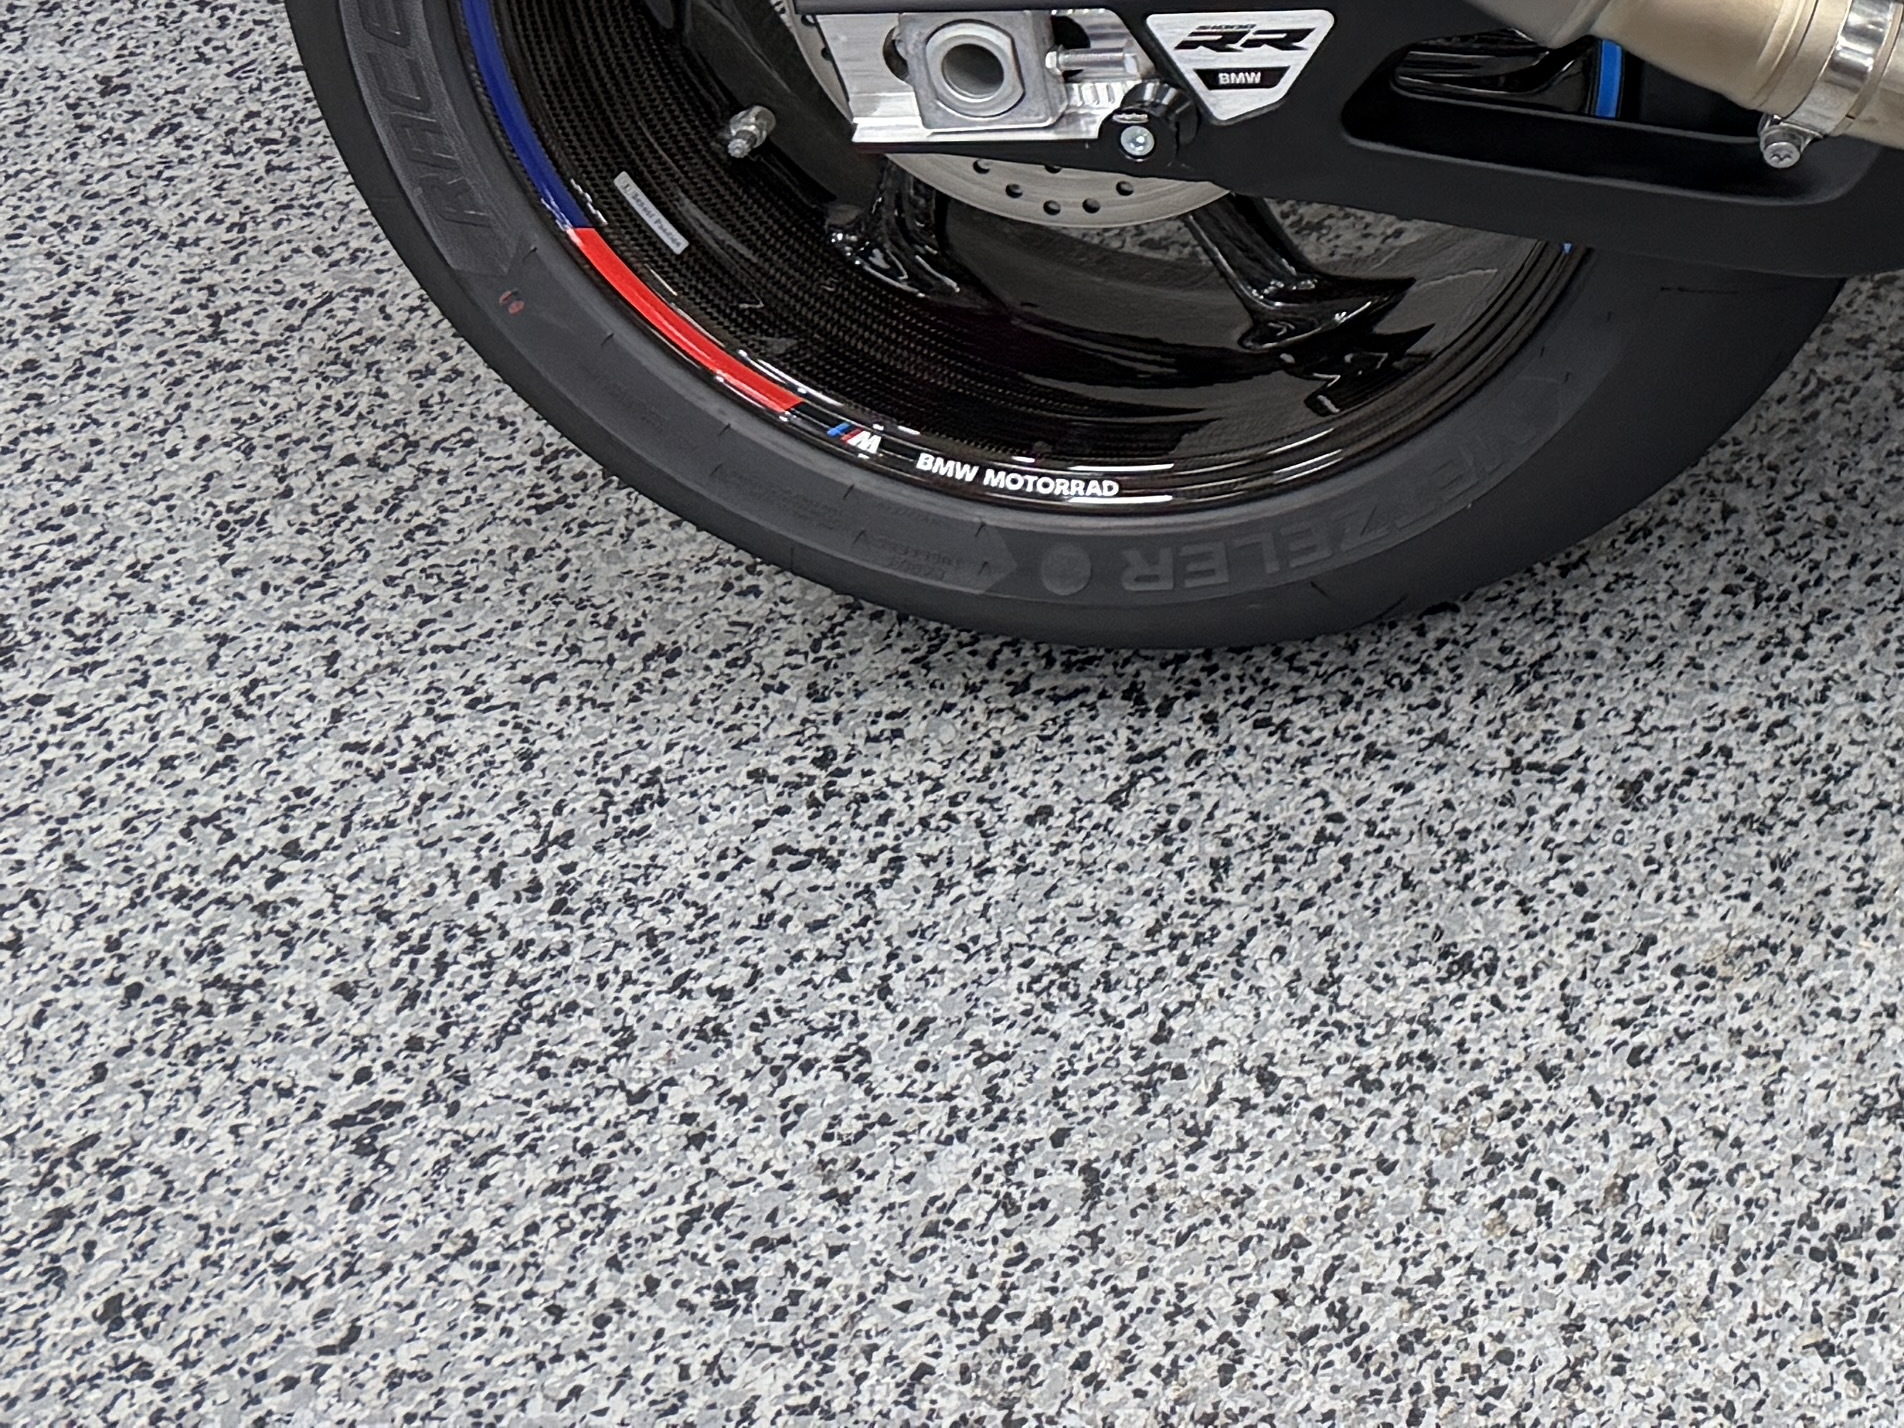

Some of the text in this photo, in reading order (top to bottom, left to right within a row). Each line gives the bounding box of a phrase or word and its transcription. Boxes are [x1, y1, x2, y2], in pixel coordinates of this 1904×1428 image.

[1173, 26, 1318, 53] RR
[1217, 70, 1262, 85] BMW
[915, 453, 978, 485] BMW
[983, 469, 1121, 500] MOTORRAD
